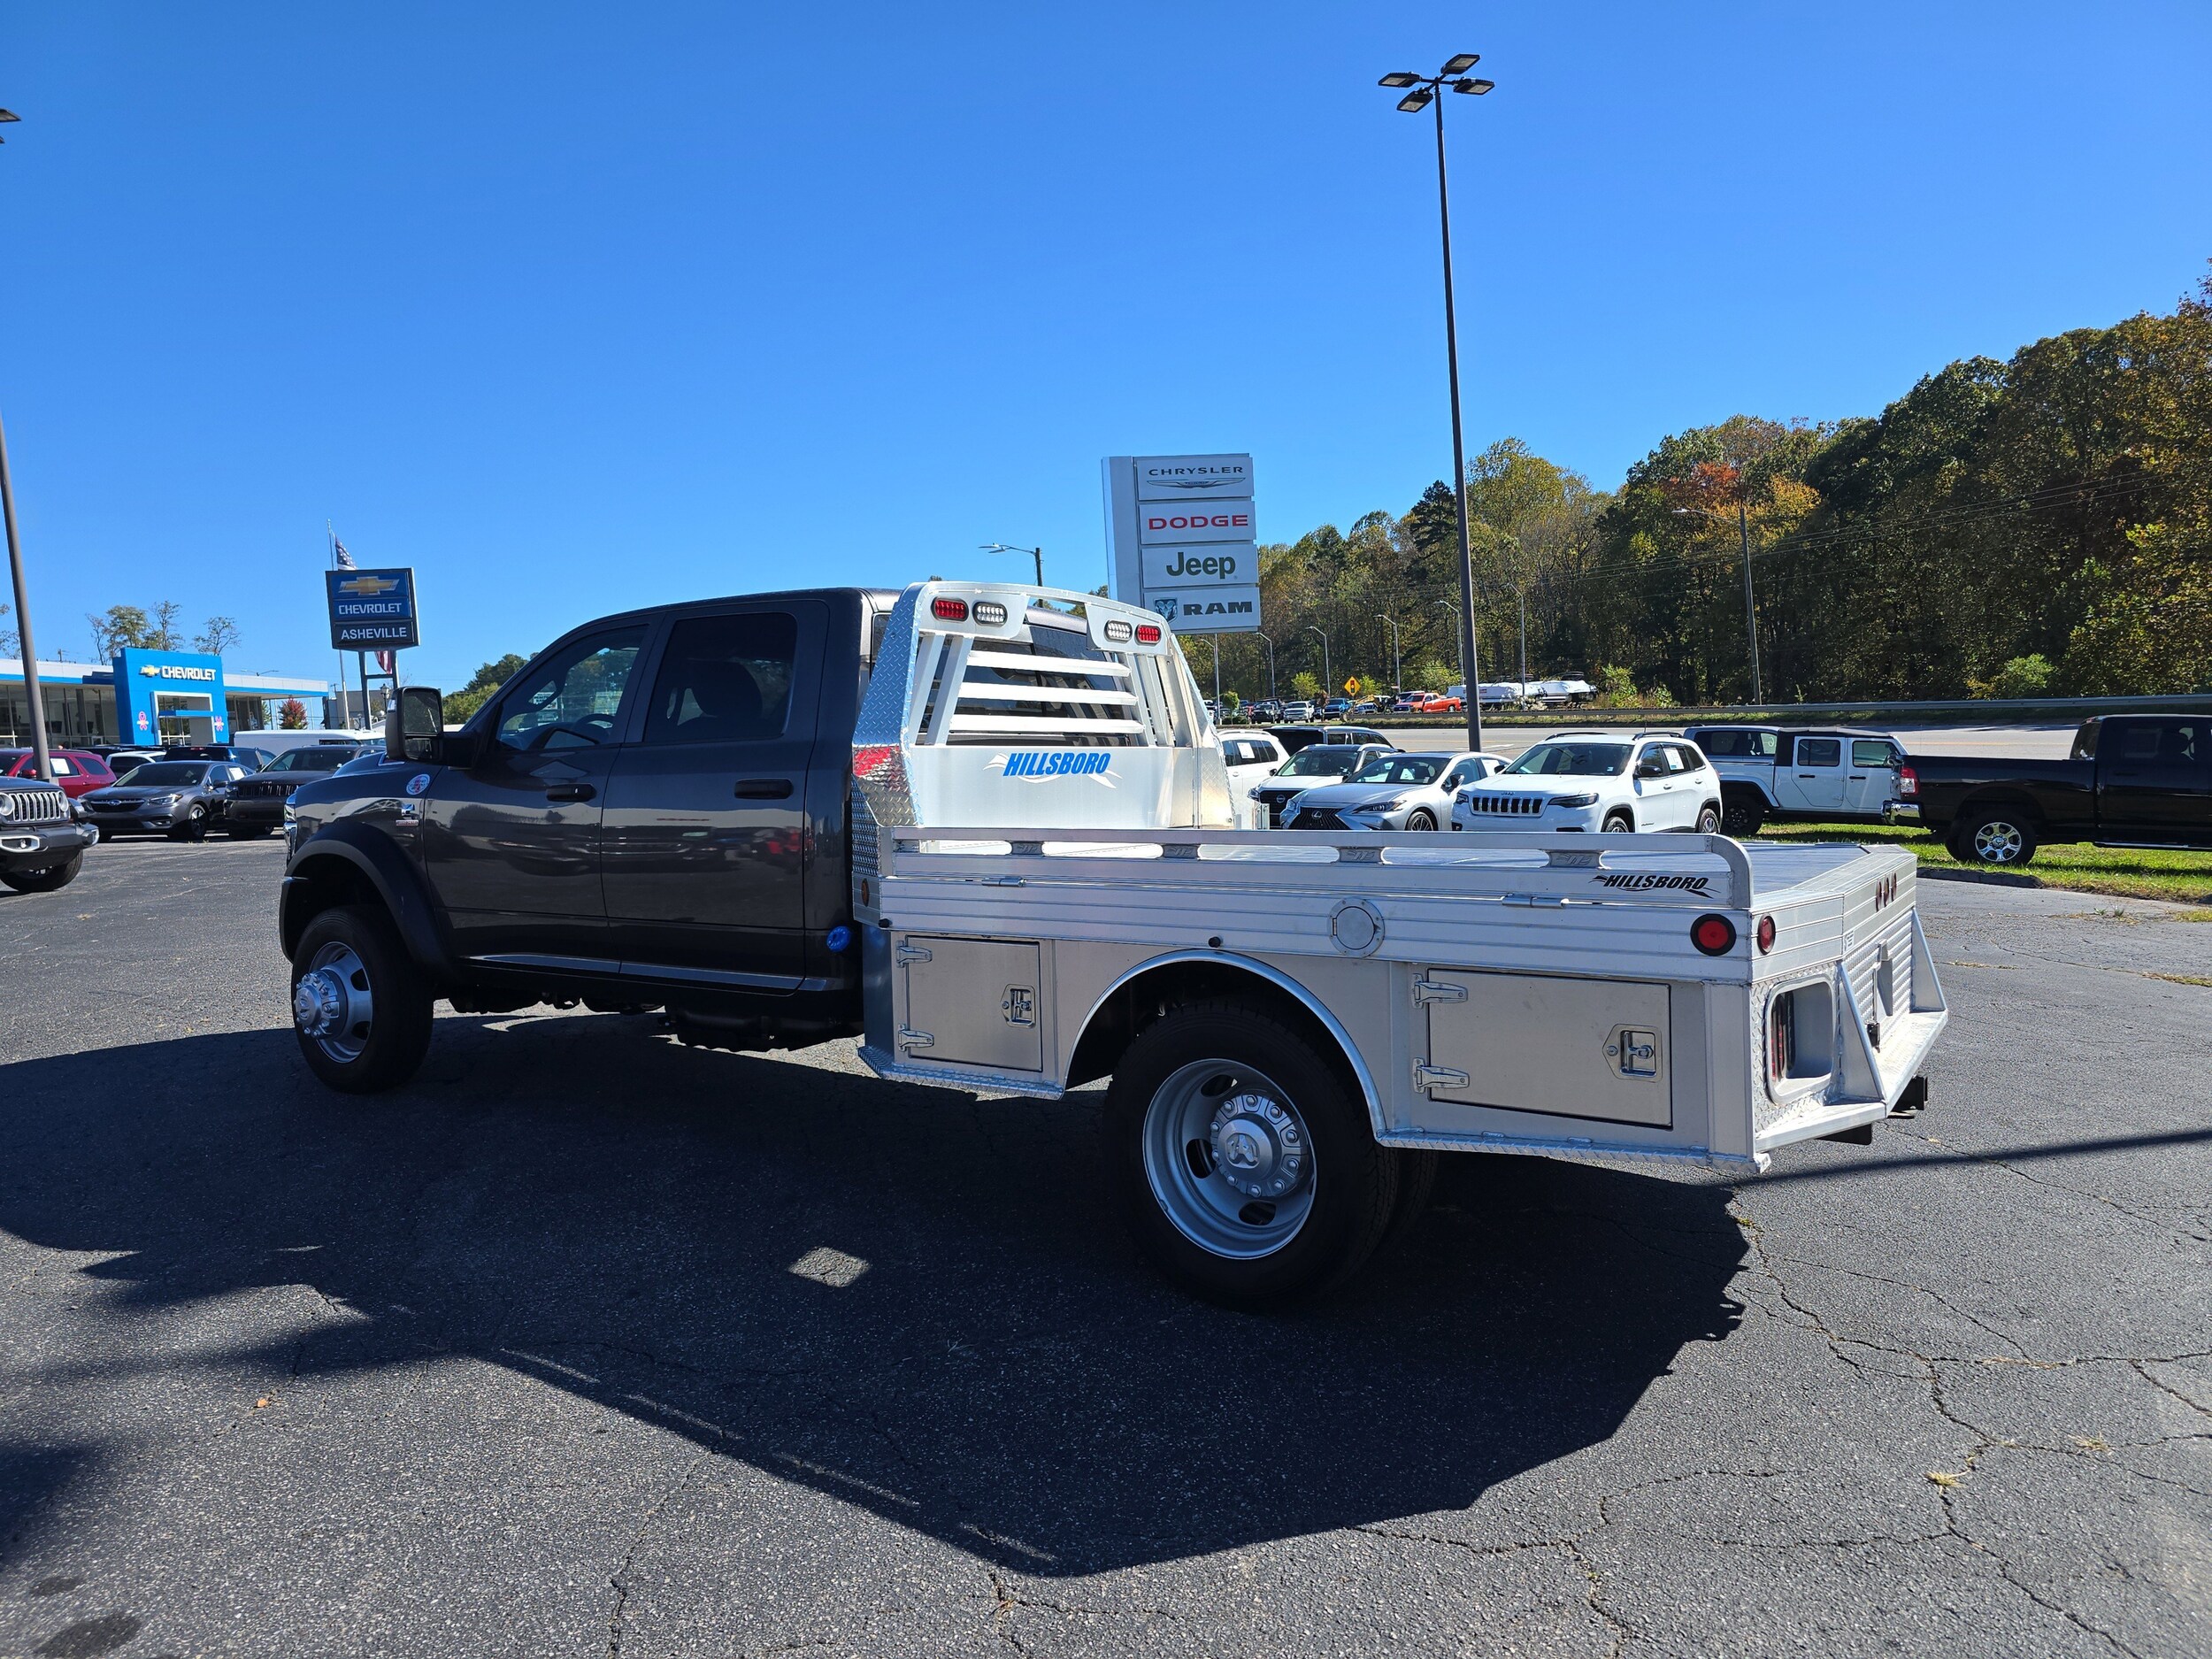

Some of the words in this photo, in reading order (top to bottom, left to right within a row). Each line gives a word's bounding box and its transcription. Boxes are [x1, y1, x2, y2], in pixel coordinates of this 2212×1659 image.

[1148, 466, 1243, 476] CHRYSLER
[1148, 515, 1248, 530] DODGE
[1166, 551, 1236, 580] Jeep
[338, 603, 402, 615] CHEVROLET
[1183, 601, 1253, 616] RAM
[341, 626, 407, 640] ASHEVILLE
[160, 665, 216, 680] CHEVROLET
[1002, 752, 1111, 777] HILLSBORO
[1602, 874, 1709, 890] HILLSBORO
